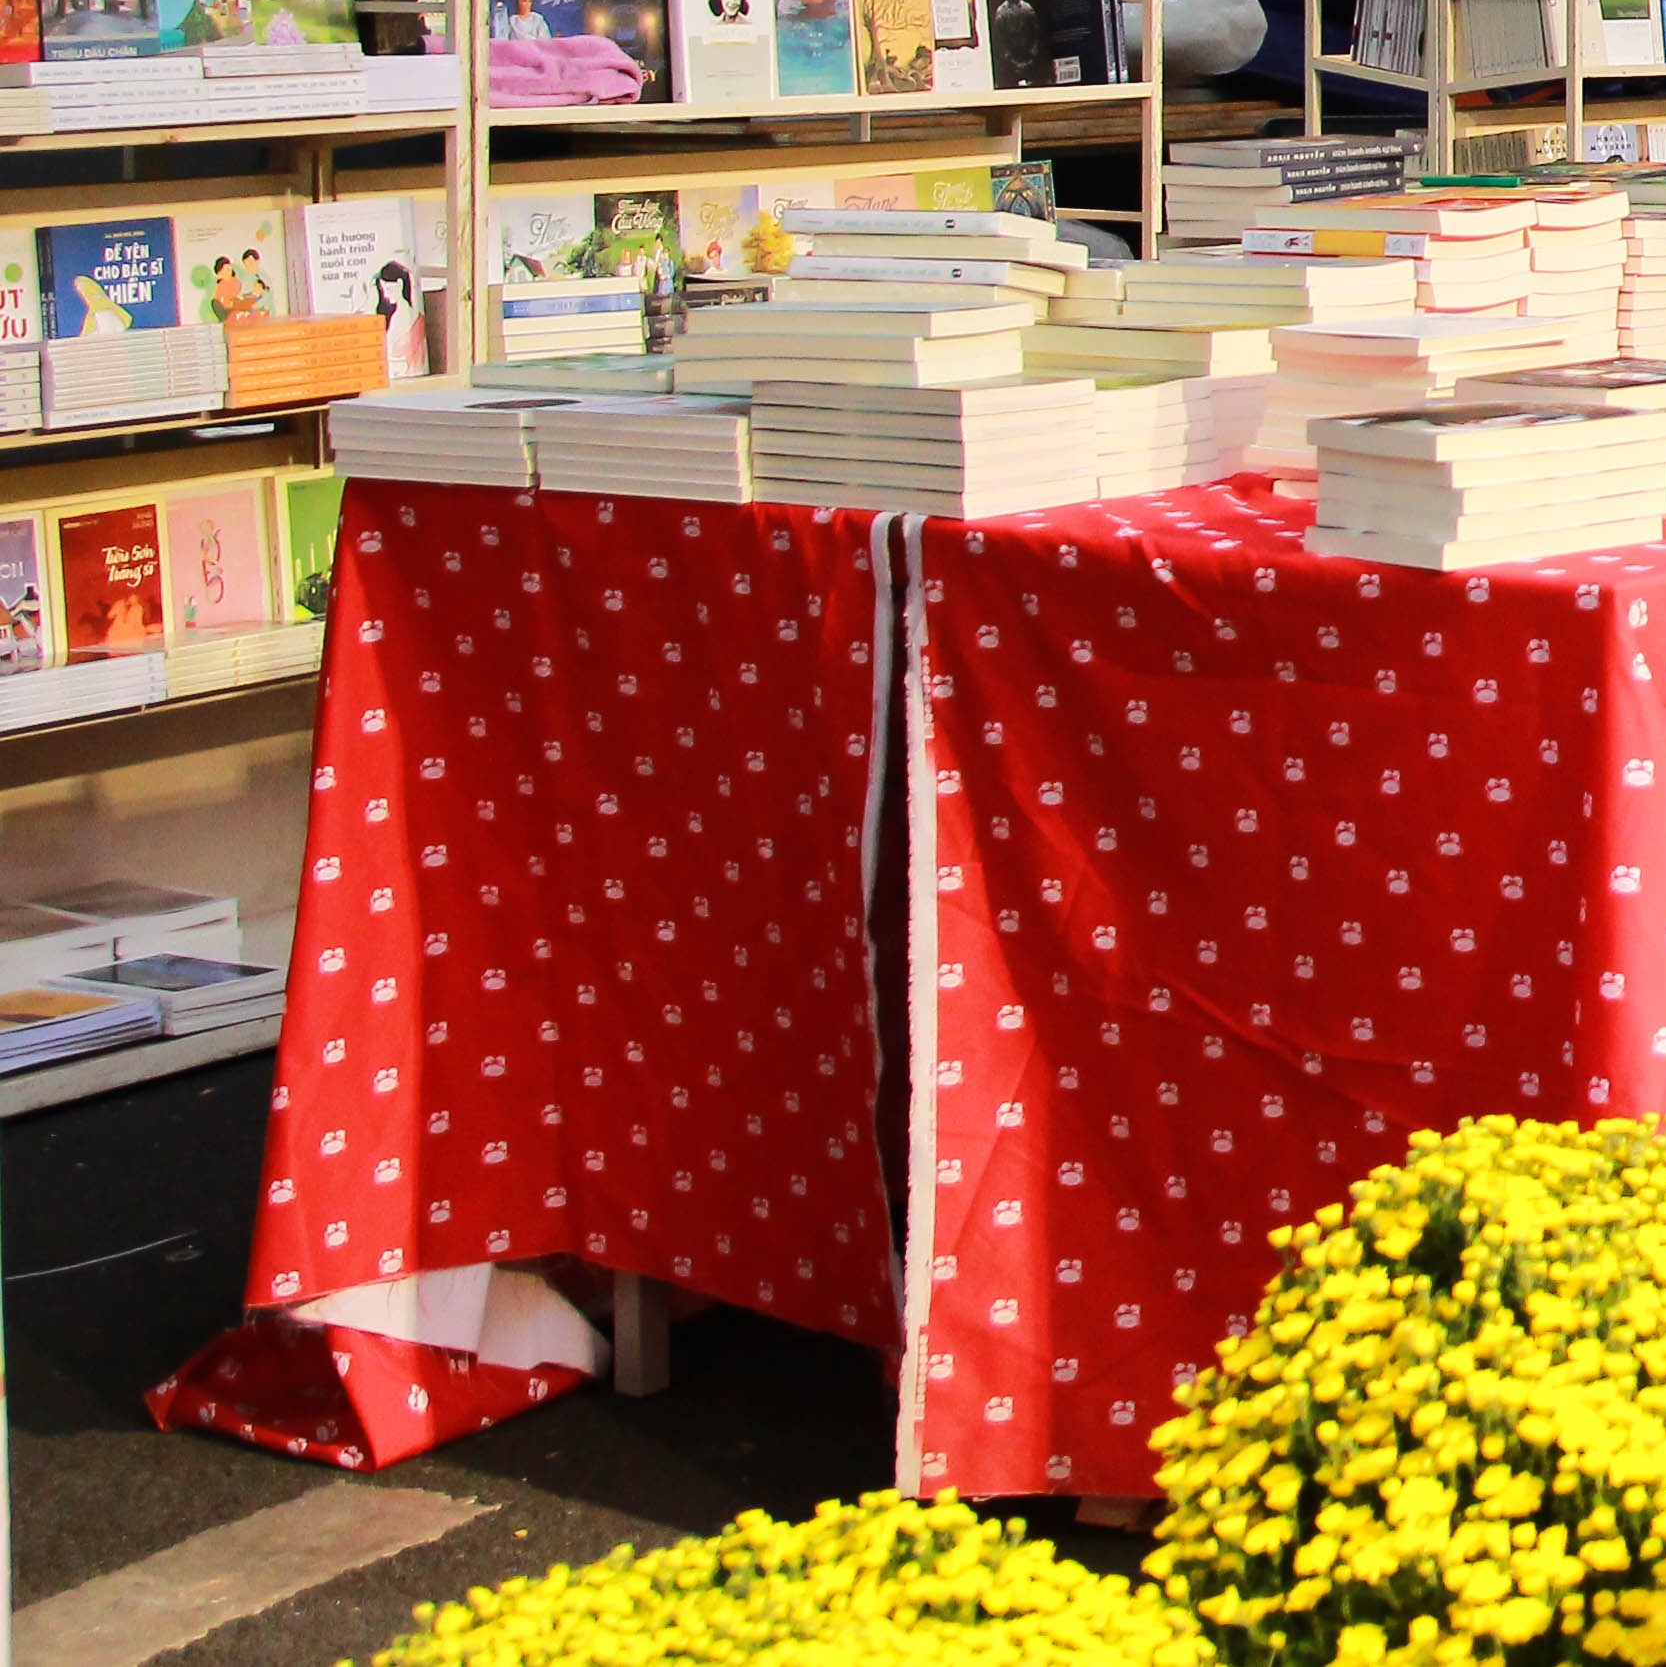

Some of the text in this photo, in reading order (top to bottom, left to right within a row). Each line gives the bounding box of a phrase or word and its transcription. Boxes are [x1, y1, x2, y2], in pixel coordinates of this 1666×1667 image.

[125, 241, 150, 259] YÊN
[347, 256, 367, 268] con
[94, 265, 120, 281] CHO
